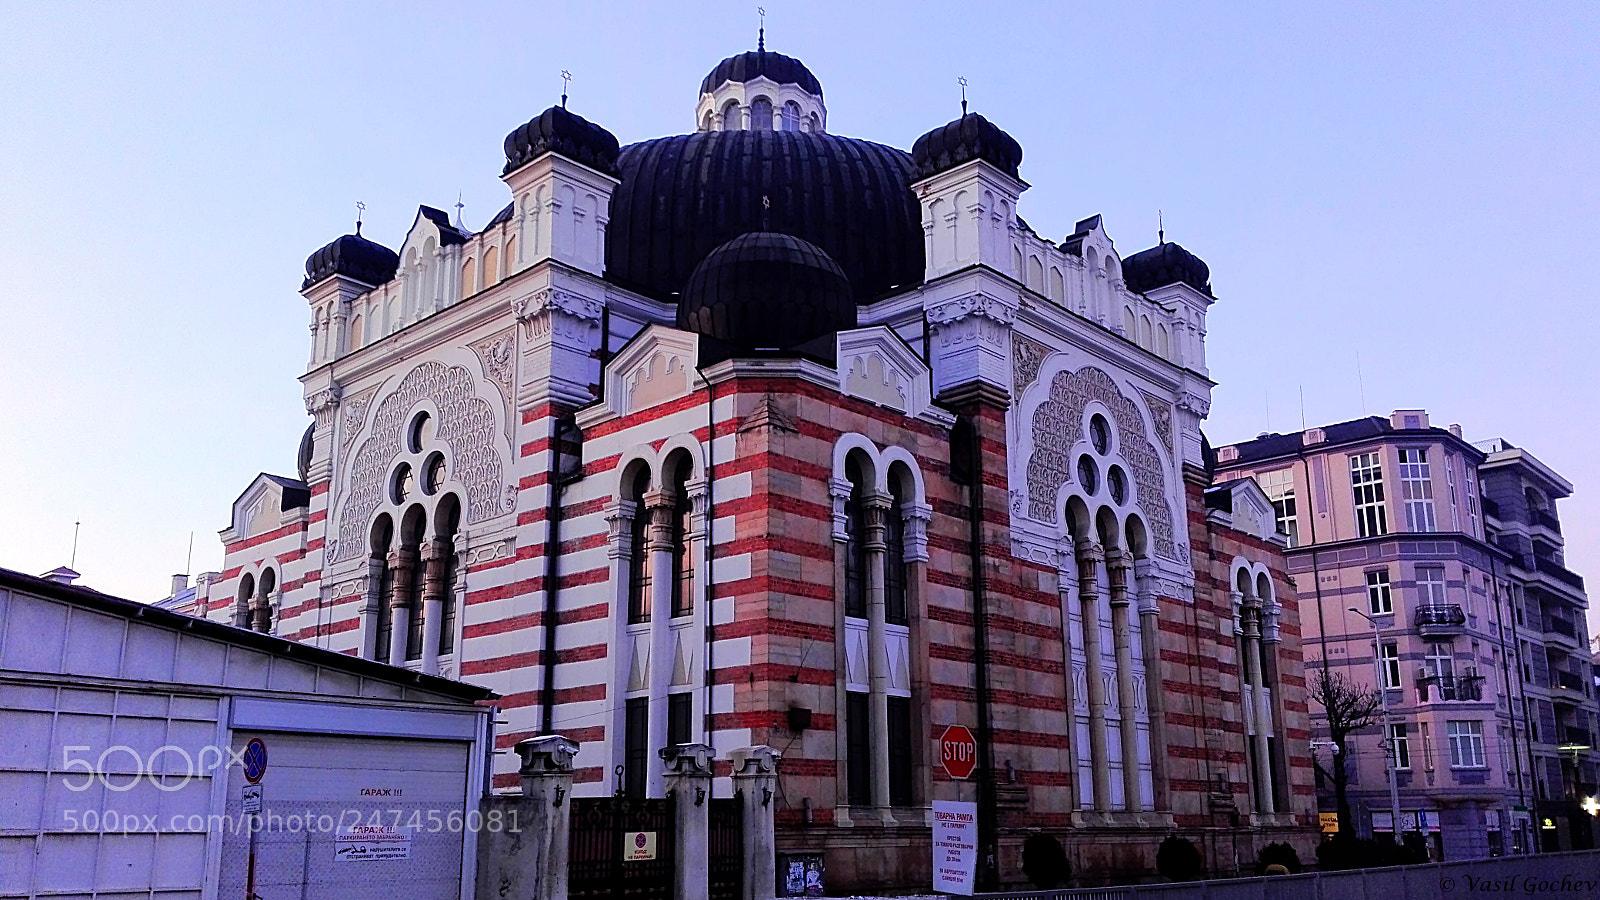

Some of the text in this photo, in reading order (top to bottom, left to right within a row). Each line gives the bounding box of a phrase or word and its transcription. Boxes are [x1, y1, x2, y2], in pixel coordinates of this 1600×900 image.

[944, 740, 973, 762] STOP
[360, 788, 391, 797] ГАРАЖ
[352, 826, 384, 834] ГАРАЖ
